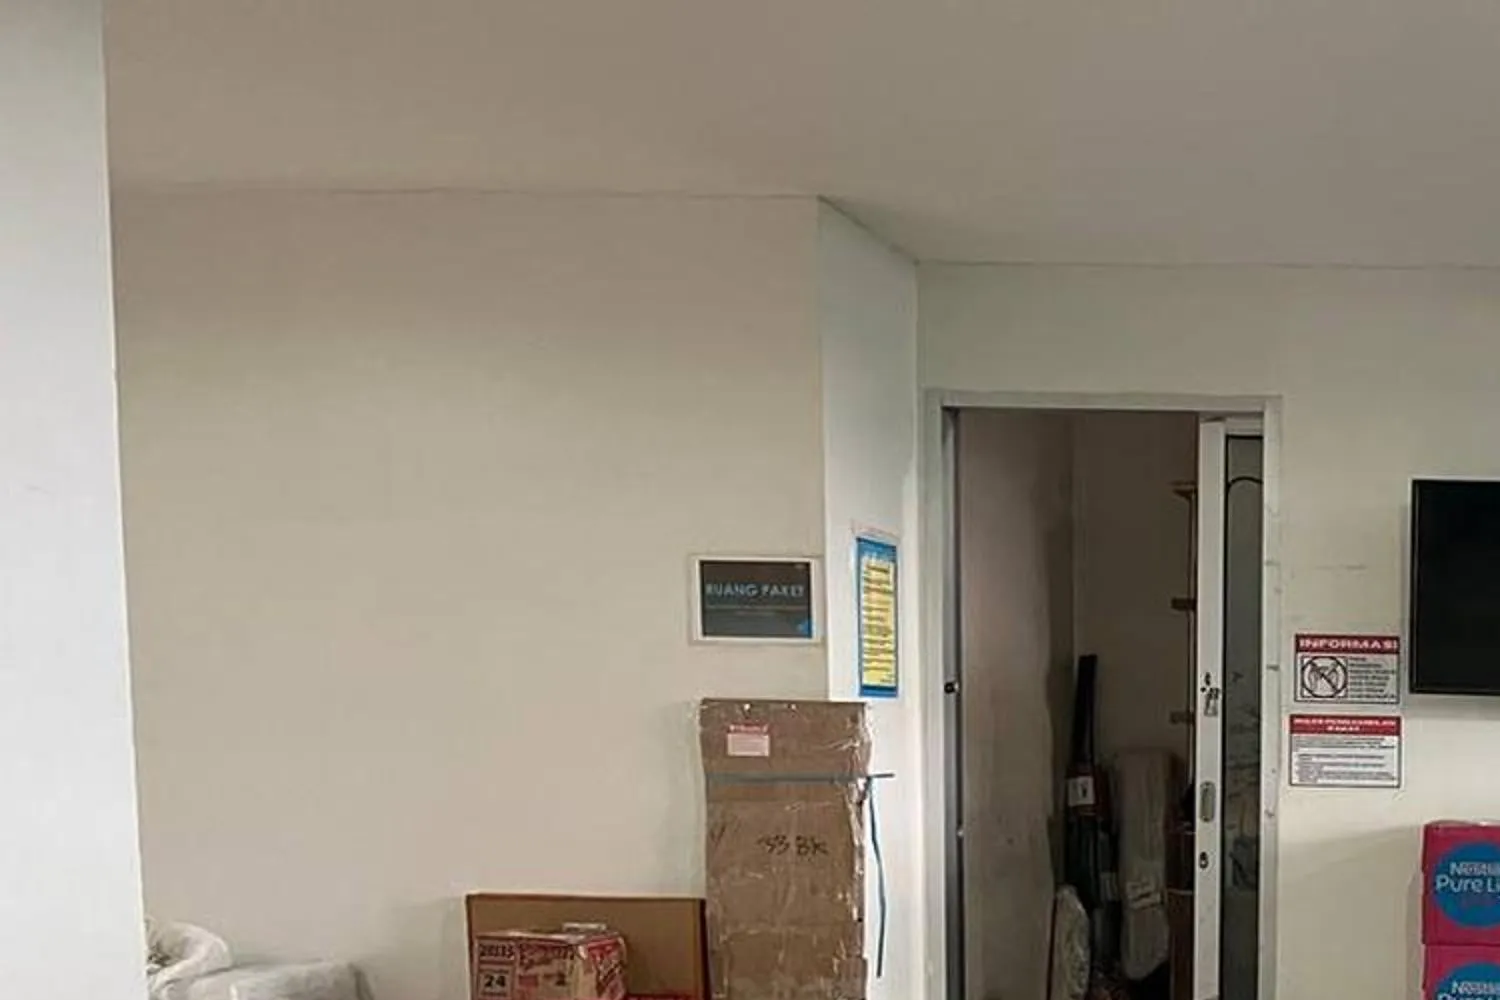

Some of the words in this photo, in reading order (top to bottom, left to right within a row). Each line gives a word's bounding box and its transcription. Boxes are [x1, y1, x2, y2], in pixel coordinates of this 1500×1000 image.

[705, 584, 757, 598] RUANG
[1299, 638, 1398, 649] INFORMASI
[1436, 874, 1483, 893] Pure
